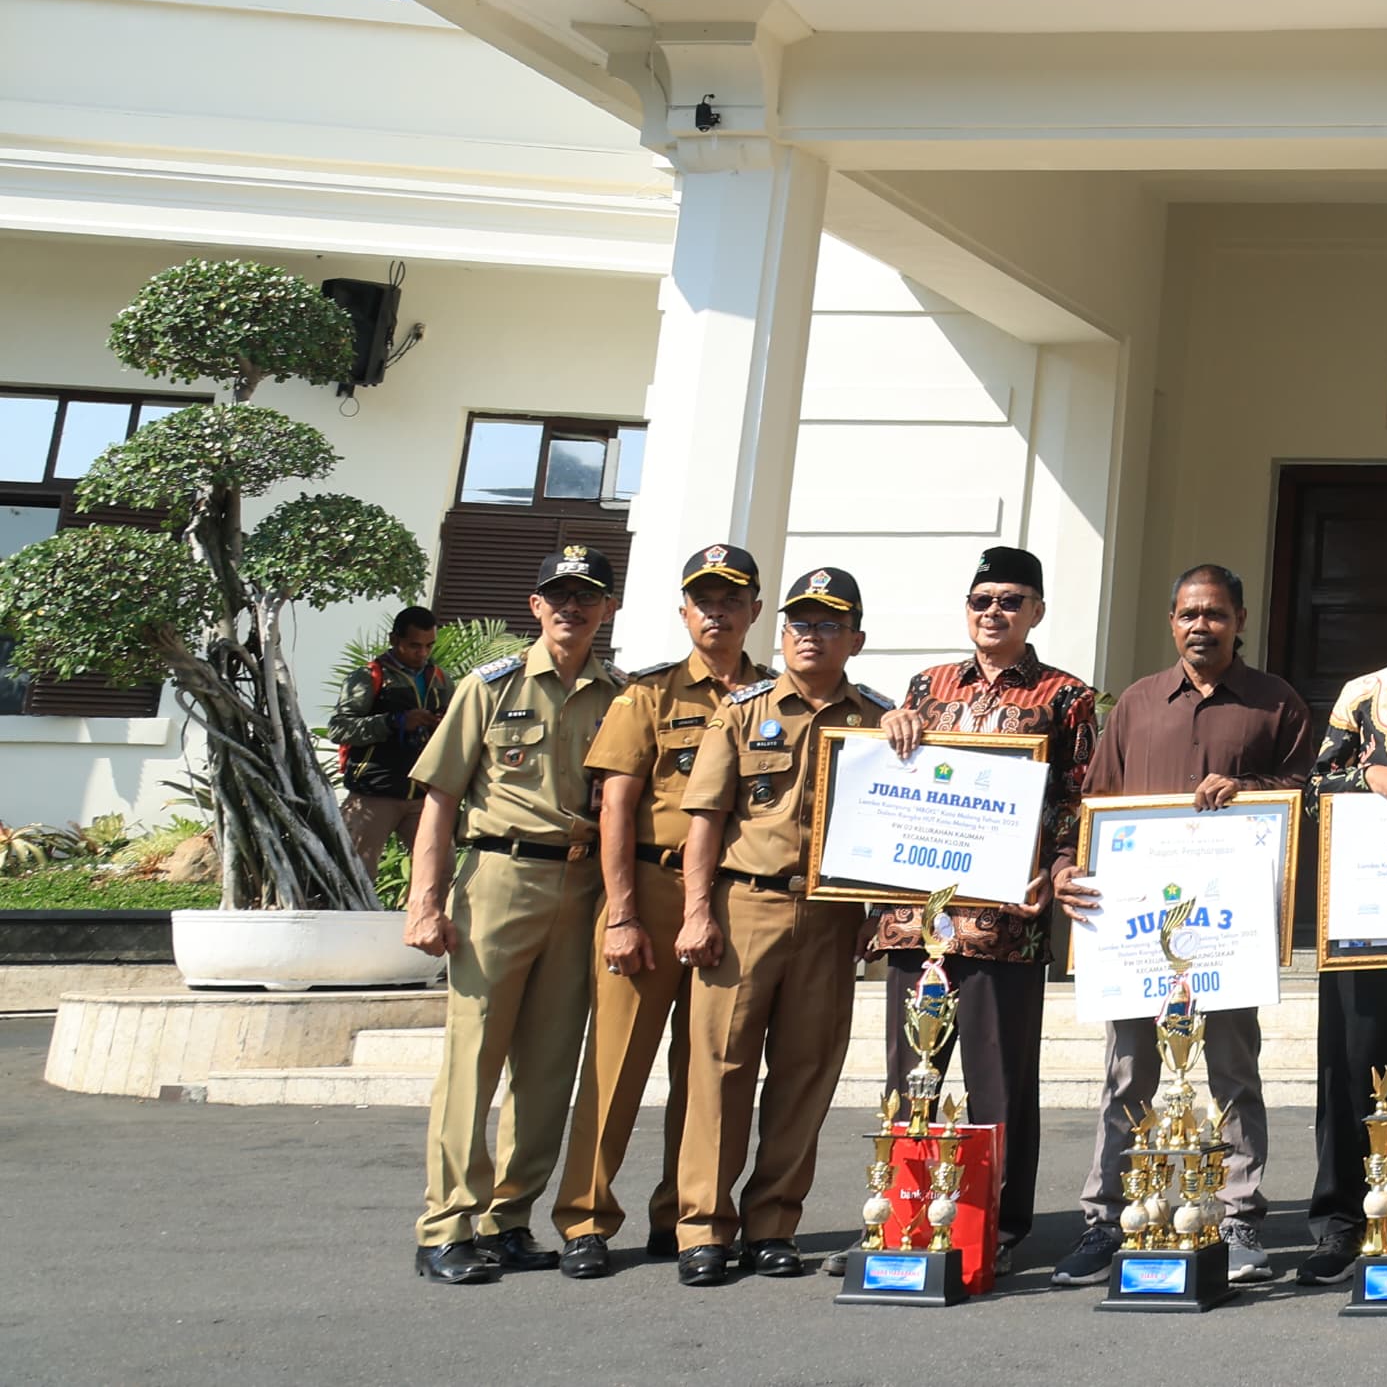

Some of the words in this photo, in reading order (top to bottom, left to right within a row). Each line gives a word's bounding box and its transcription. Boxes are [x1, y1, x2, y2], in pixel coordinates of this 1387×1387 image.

[868, 783, 923, 802] JUARA
[926, 788, 1007, 815] HARAPAN
[1009, 803, 1017, 816] 1
[894, 843, 972, 873] 2.000.000
[1125, 908, 1211, 940] JUA
[1217, 910, 1233, 930] 3
[1144, 971, 1220, 998] 2.5000
